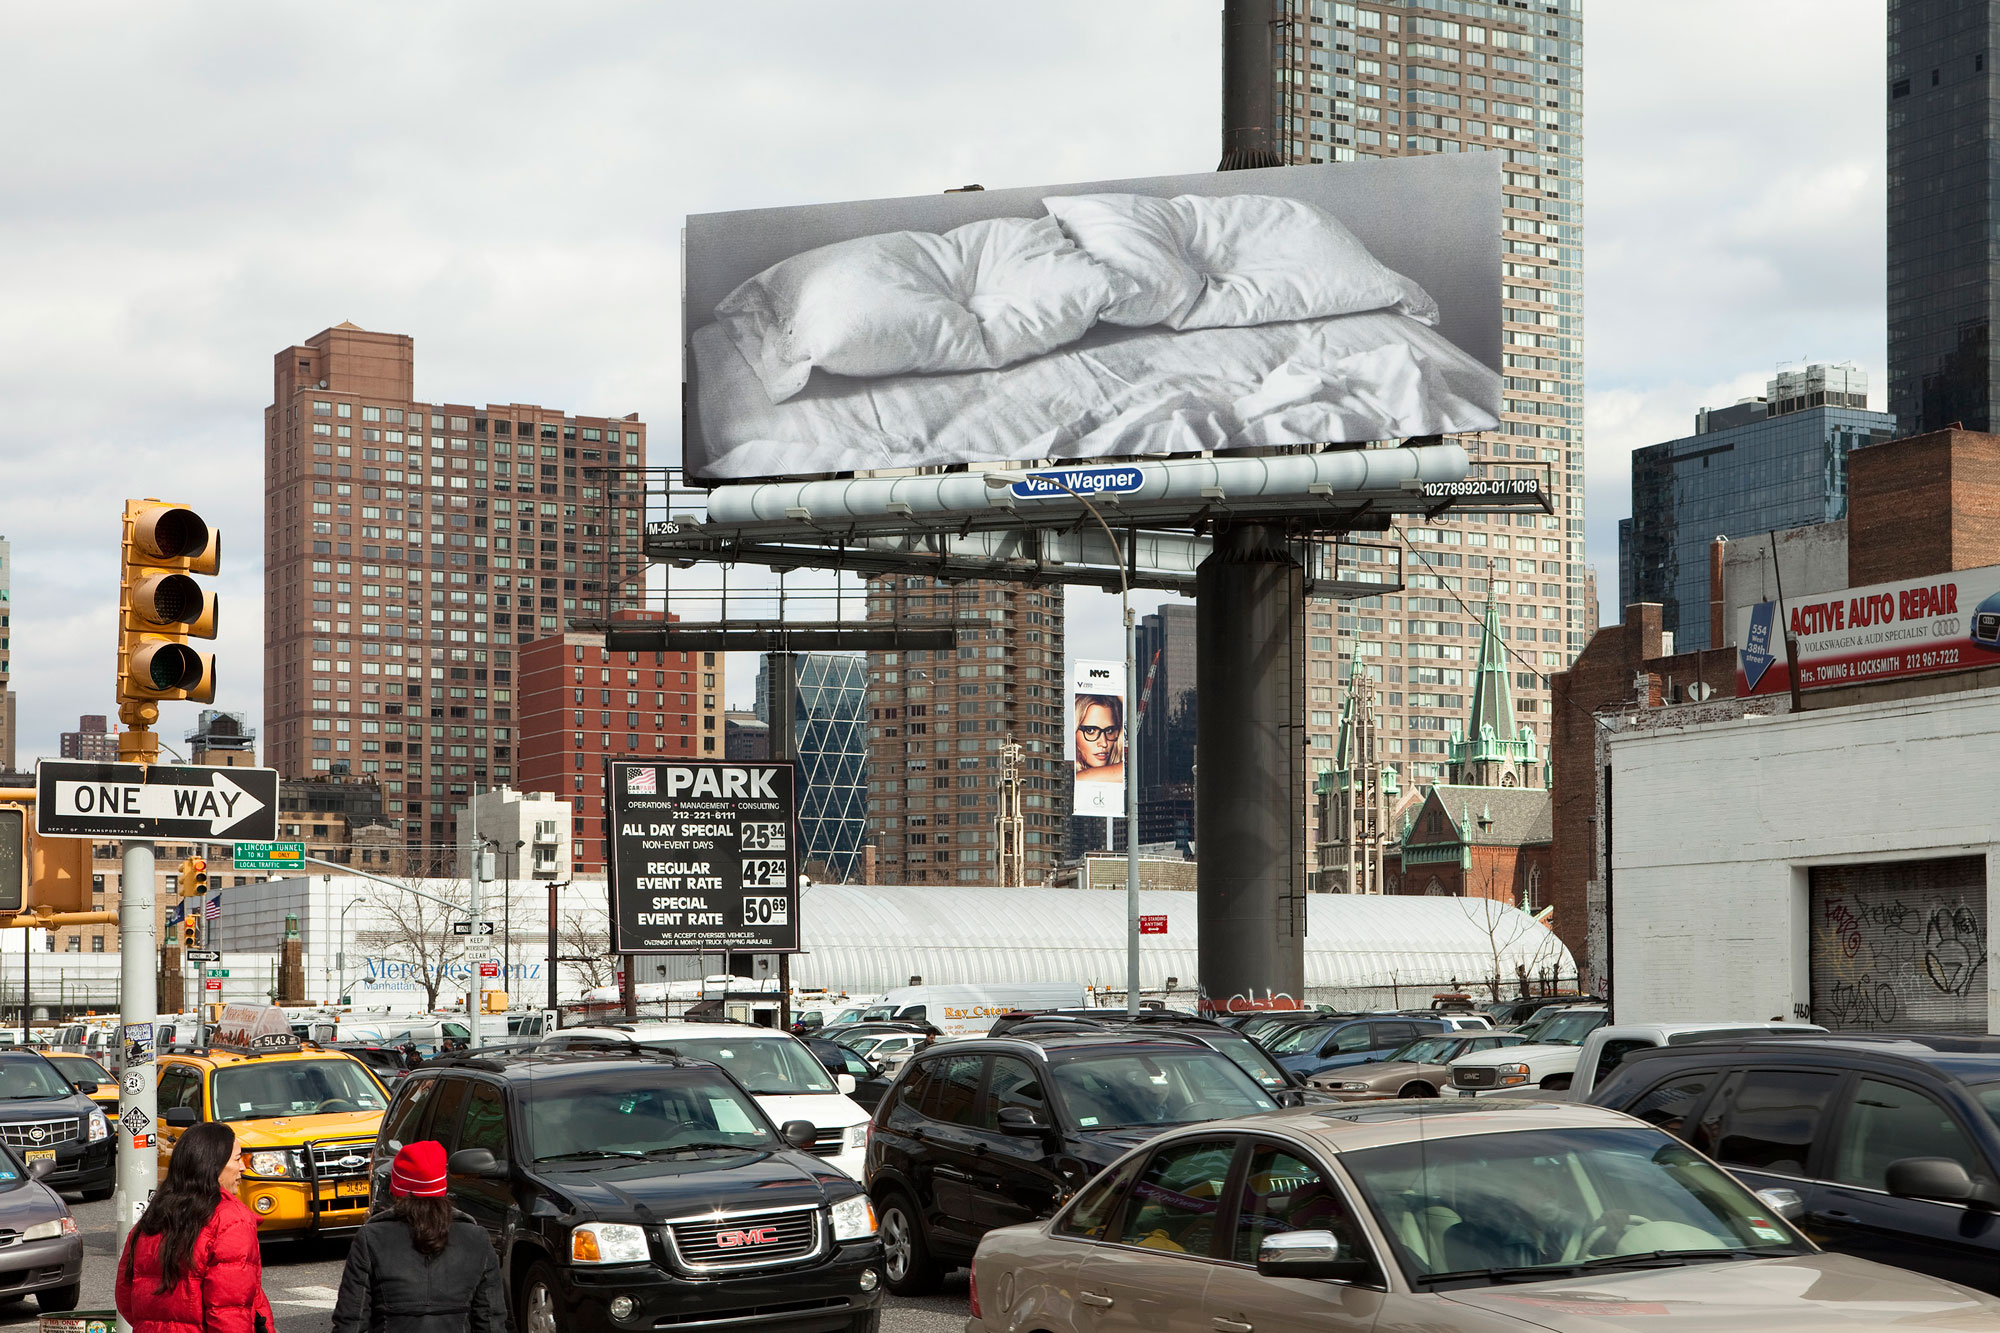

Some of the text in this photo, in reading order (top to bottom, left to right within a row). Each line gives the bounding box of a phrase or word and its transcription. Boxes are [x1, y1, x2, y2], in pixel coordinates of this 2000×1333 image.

[1026, 472, 1136, 491] Van Wagner
[1424, 480, 1538, 497] 102789920-01/1019
[648, 522, 680, 535] M-263
[1790, 583, 1958, 636] ACTIVE AUTO REPAIR
[1751, 624, 1767, 636] 554
[1804, 626, 1928, 653] VOLKSWAGEN & AUDI SPECIALIST
[1747, 642, 1765, 656] 38th
[1800, 648, 1959, 683] Hrs. TOWING & LOCKSMITH 212 967-7222
[1089, 669, 1110, 678] NYC
[666, 767, 778, 799] PARK
[74, 785, 242, 818] ONE WAY
[628, 801, 780, 810] OPERATIONS MANAGEMENT CONSULTING
[672, 811, 736, 820] 212-221-6111
[622, 823, 734, 837] ALL DAY SPECIAL
[244, 843, 303, 852] LINCOLN TUNNEL
[642, 840, 714, 850] NON-EVENT DAYS
[647, 862, 711, 875] REGULAR
[636, 877, 723, 890] EVENT RATE
[652, 897, 708, 910] SPECIAL
[638, 913, 724, 925] EVENT RATE
[468, 952, 487, 960] CLEAR
[944, 1007, 969, 1019] Ray
[264, 1035, 287, 1047] 5L43
[716, 1227, 779, 1248] GMC
